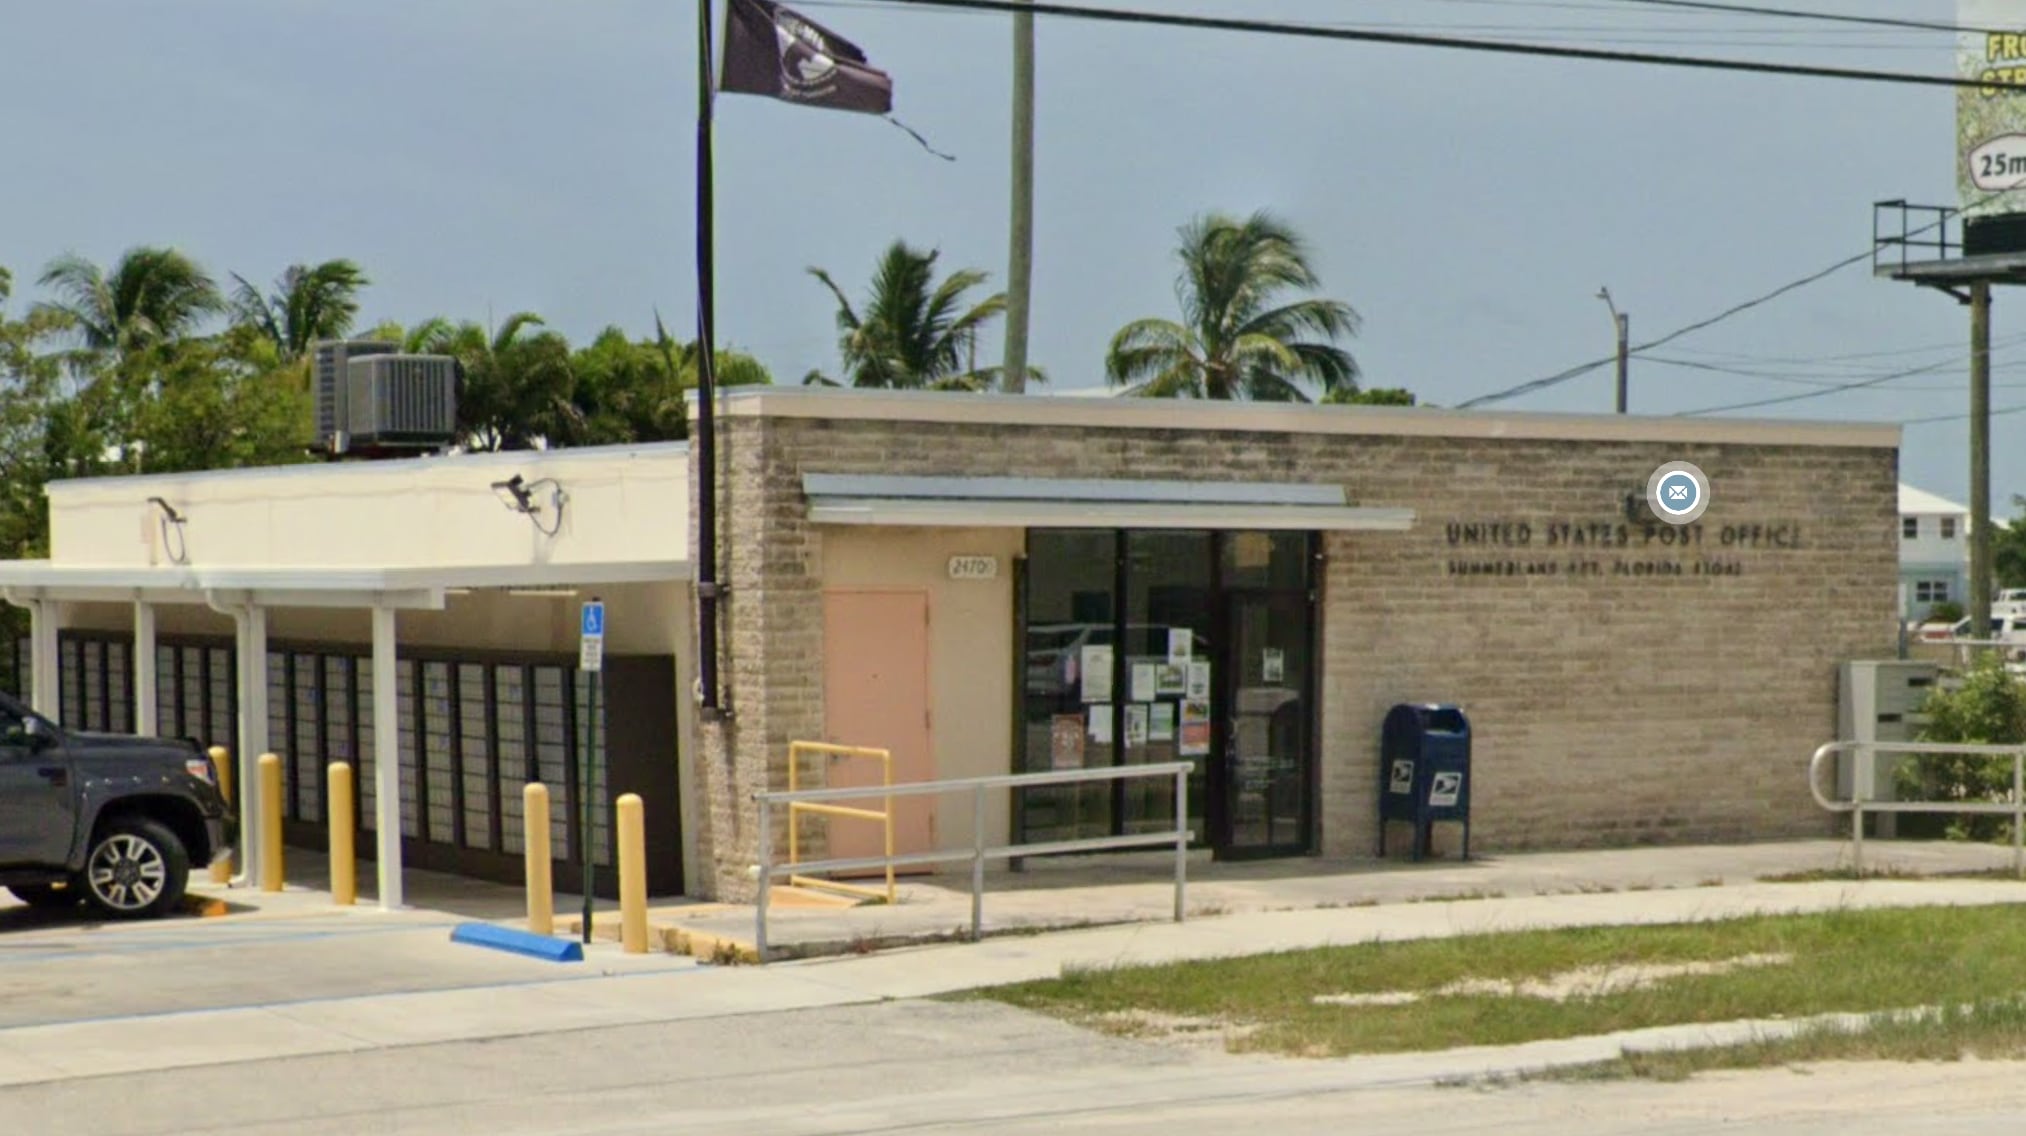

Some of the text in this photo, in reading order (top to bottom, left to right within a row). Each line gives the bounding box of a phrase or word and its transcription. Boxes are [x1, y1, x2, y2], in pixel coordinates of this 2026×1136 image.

[1447, 522, 1800, 549] UNITED STATES POST OFFICE
